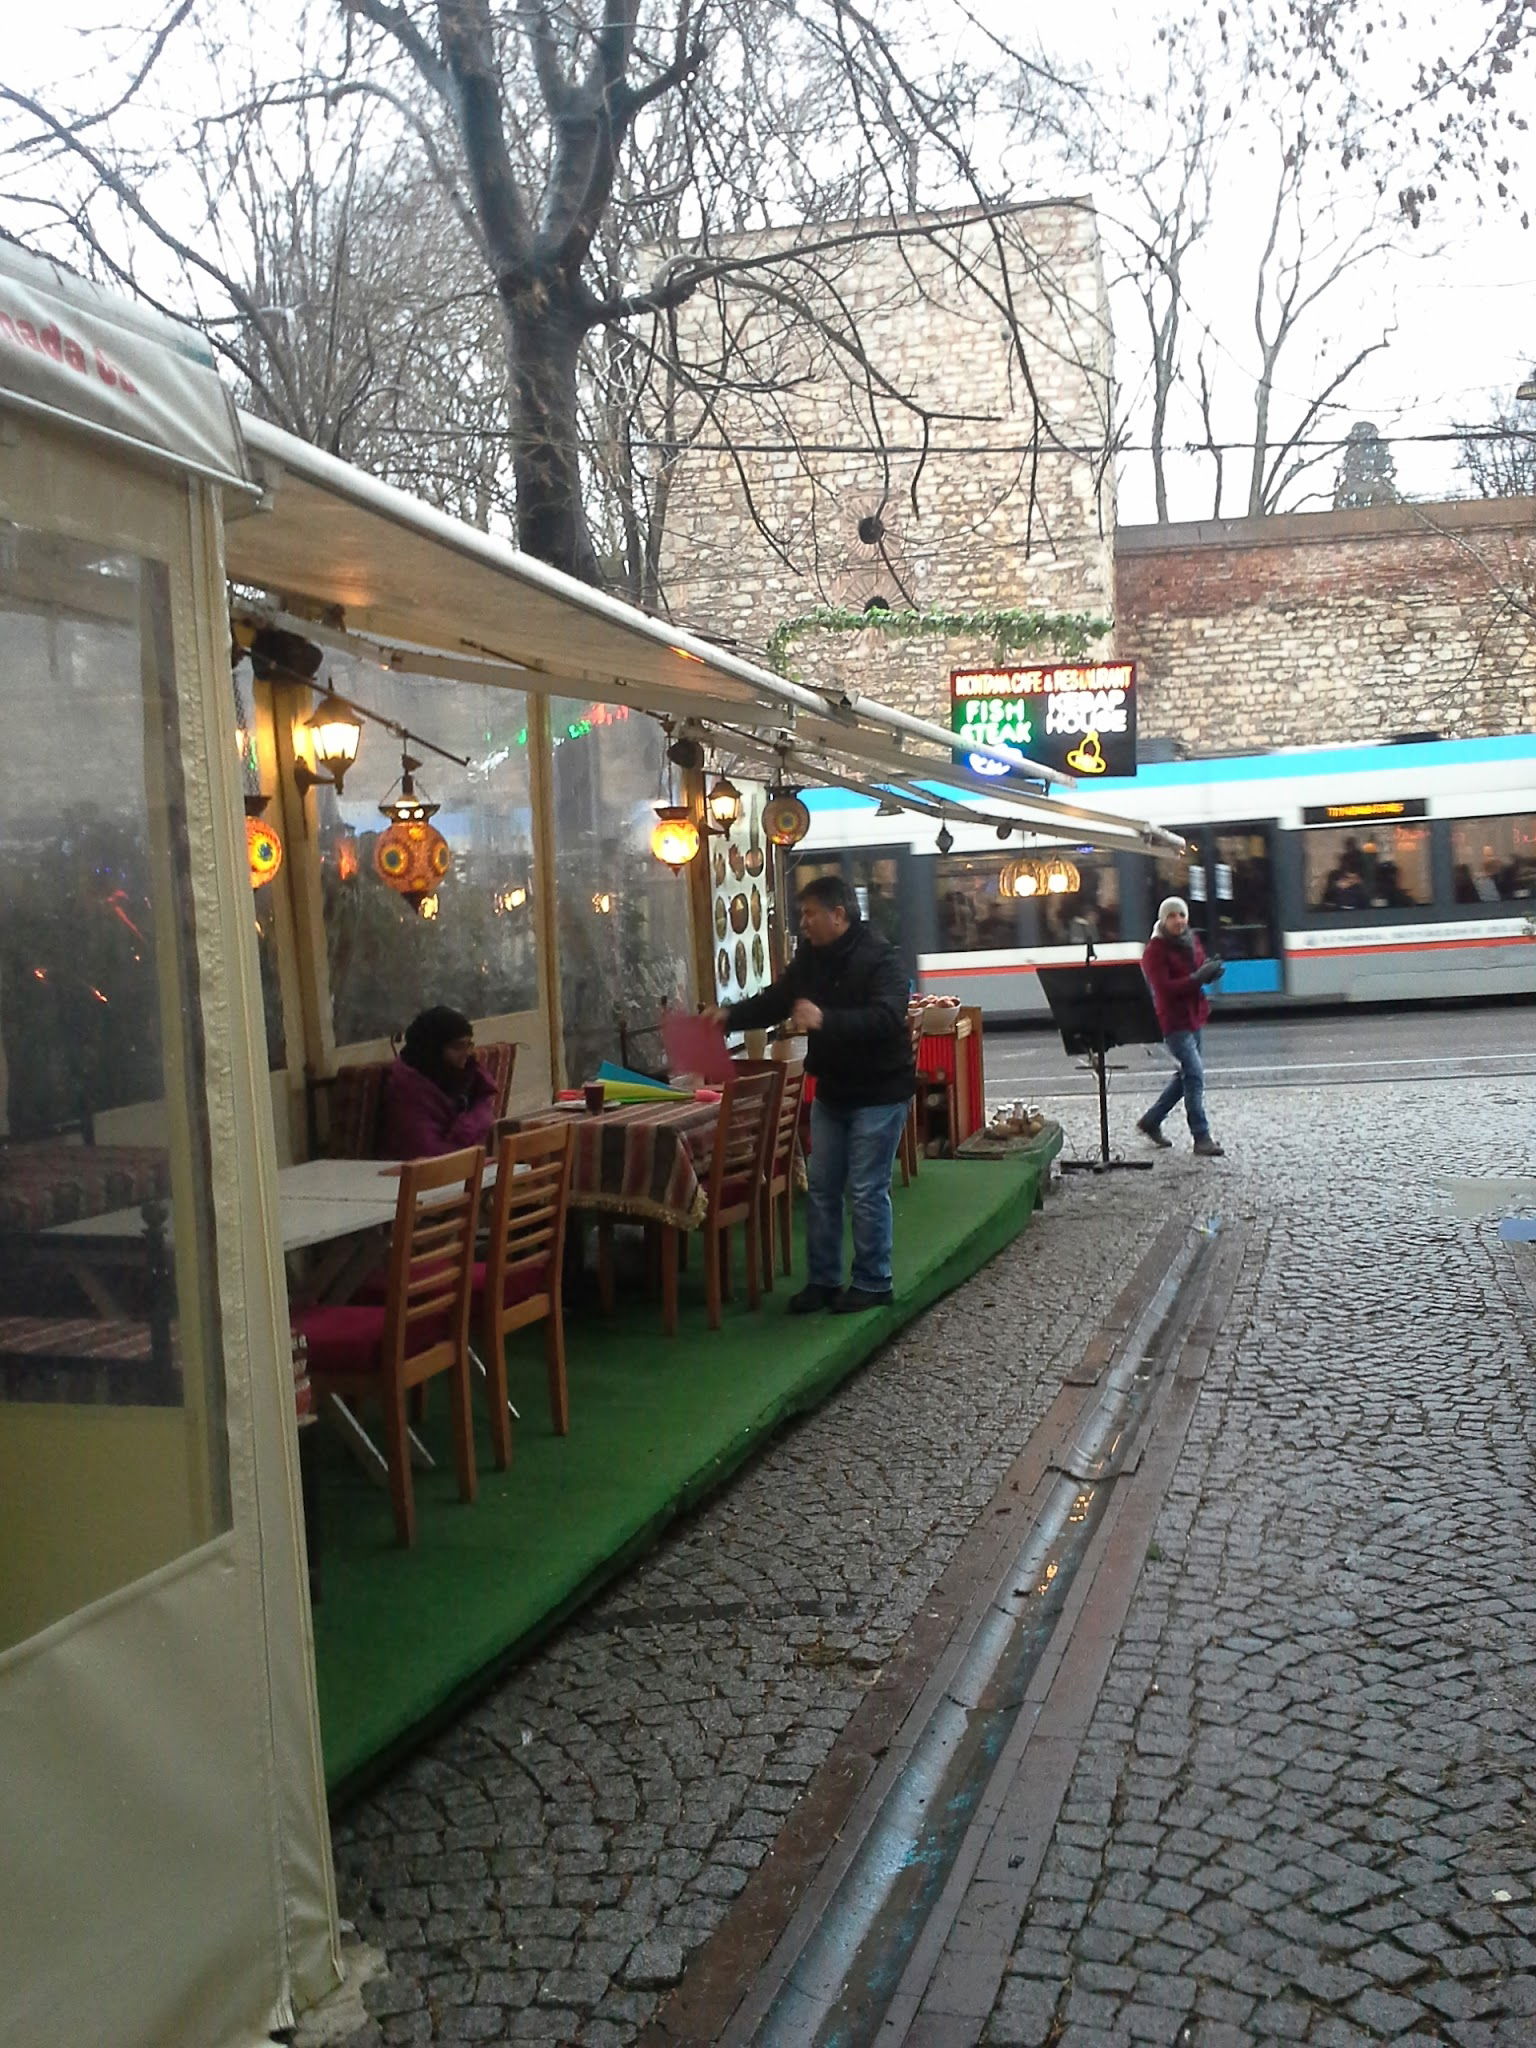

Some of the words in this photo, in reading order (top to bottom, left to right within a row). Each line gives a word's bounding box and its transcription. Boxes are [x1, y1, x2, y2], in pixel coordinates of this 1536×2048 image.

[1011, 671, 1043, 693] CAFE
[1044, 674, 1053, 691] &
[1054, 667, 1132, 691] RESTAURANT
[966, 699, 1024, 723] FISH
[1046, 710, 1127, 734] HOUSE
[960, 721, 1032, 744] STEAK
